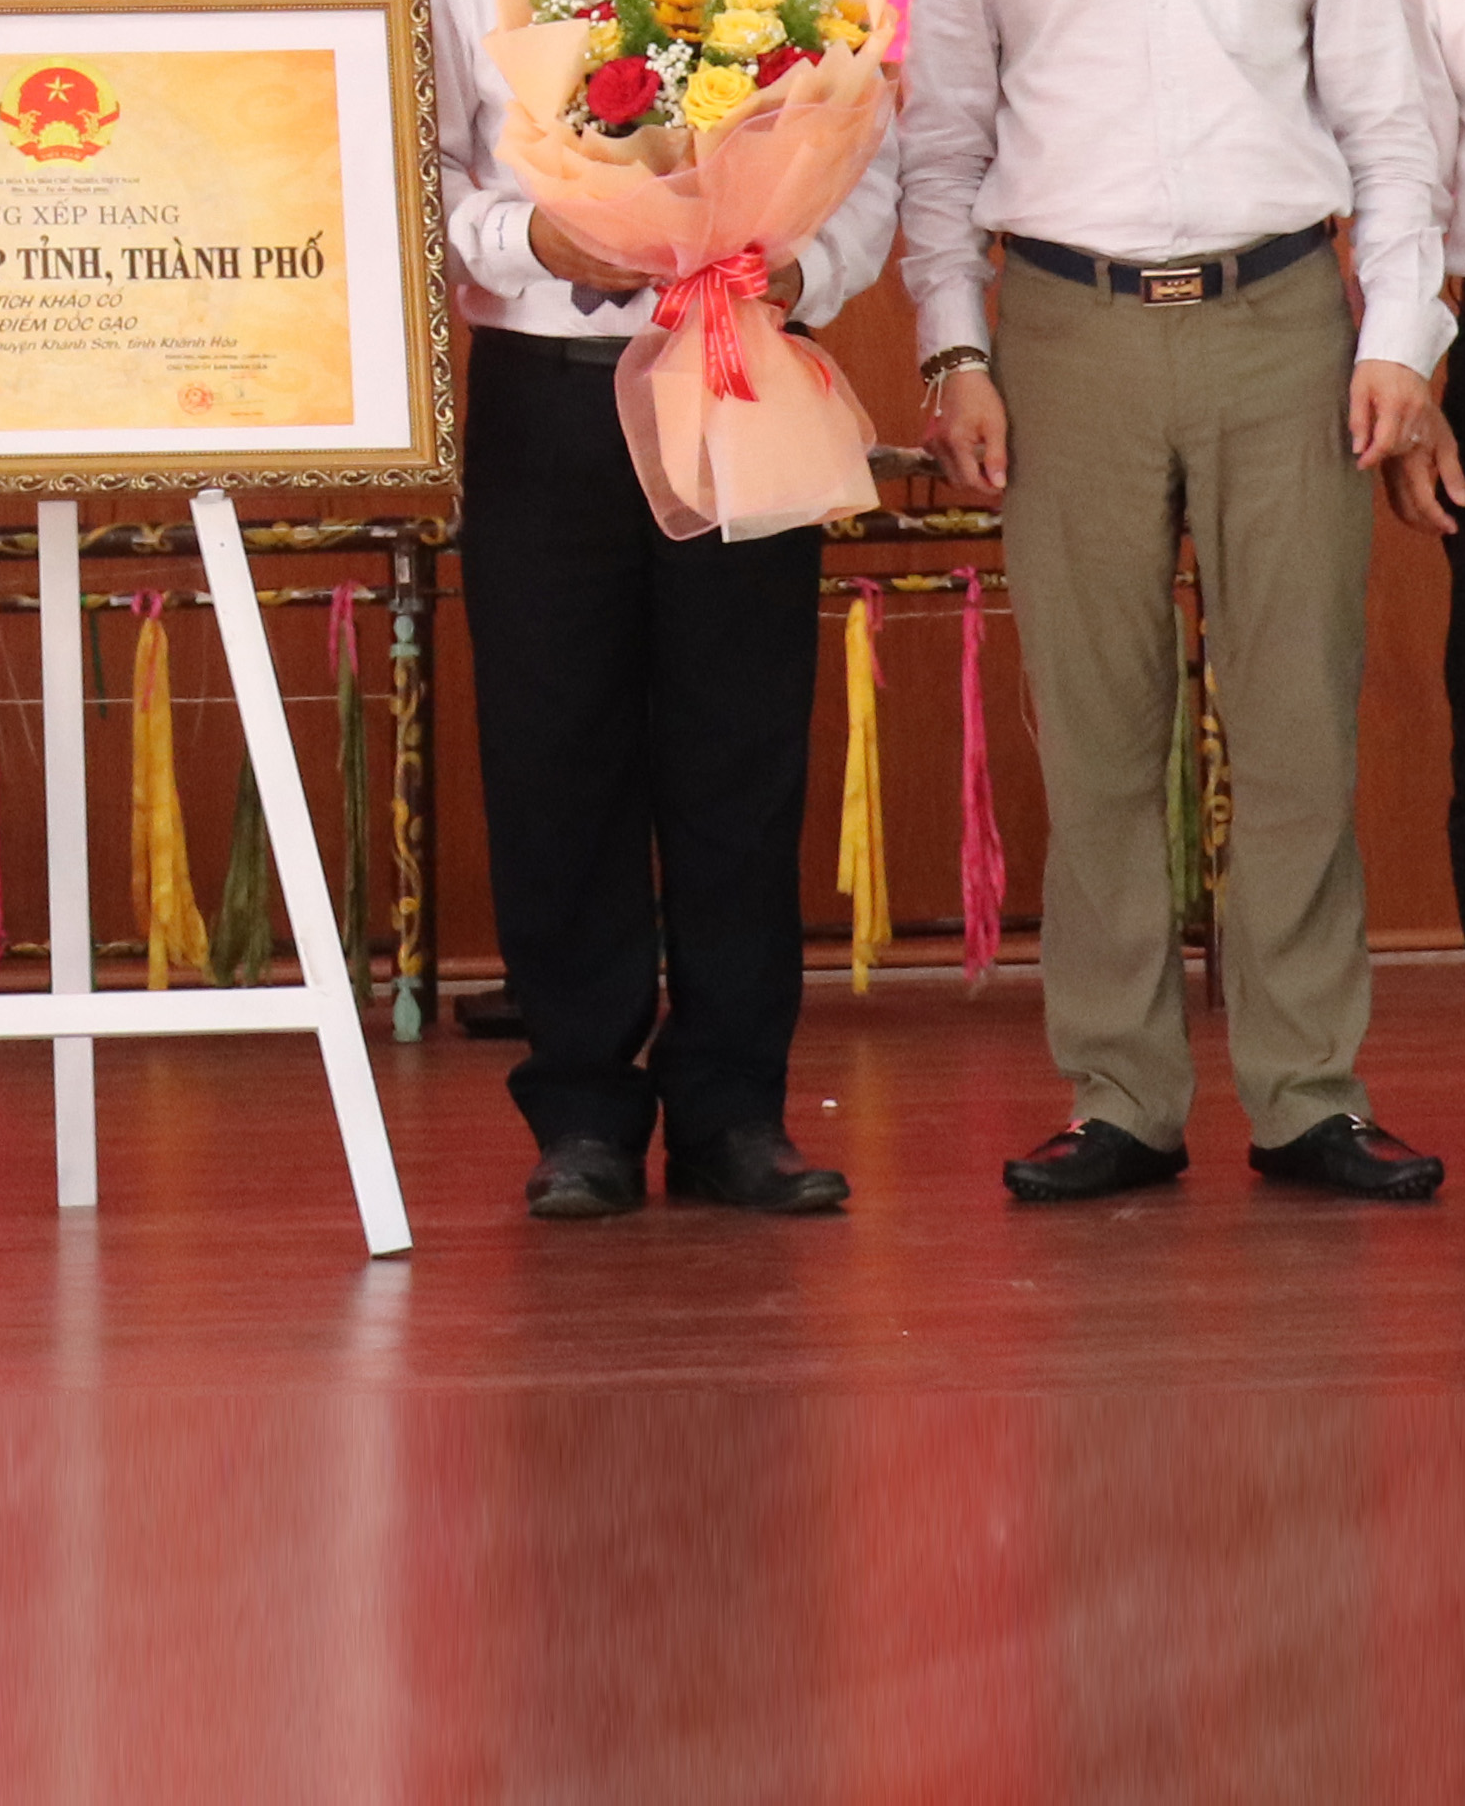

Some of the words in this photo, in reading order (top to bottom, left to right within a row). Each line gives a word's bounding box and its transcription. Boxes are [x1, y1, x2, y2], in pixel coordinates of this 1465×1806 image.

[32, 197, 88, 225] XẾP
[98, 204, 180, 230] HẠNG
[16, 234, 114, 285] TỈNH,
[121, 236, 242, 281] THÀNH
[252, 230, 325, 280] PHỐ
[98, 316, 139, 335] GẠO
